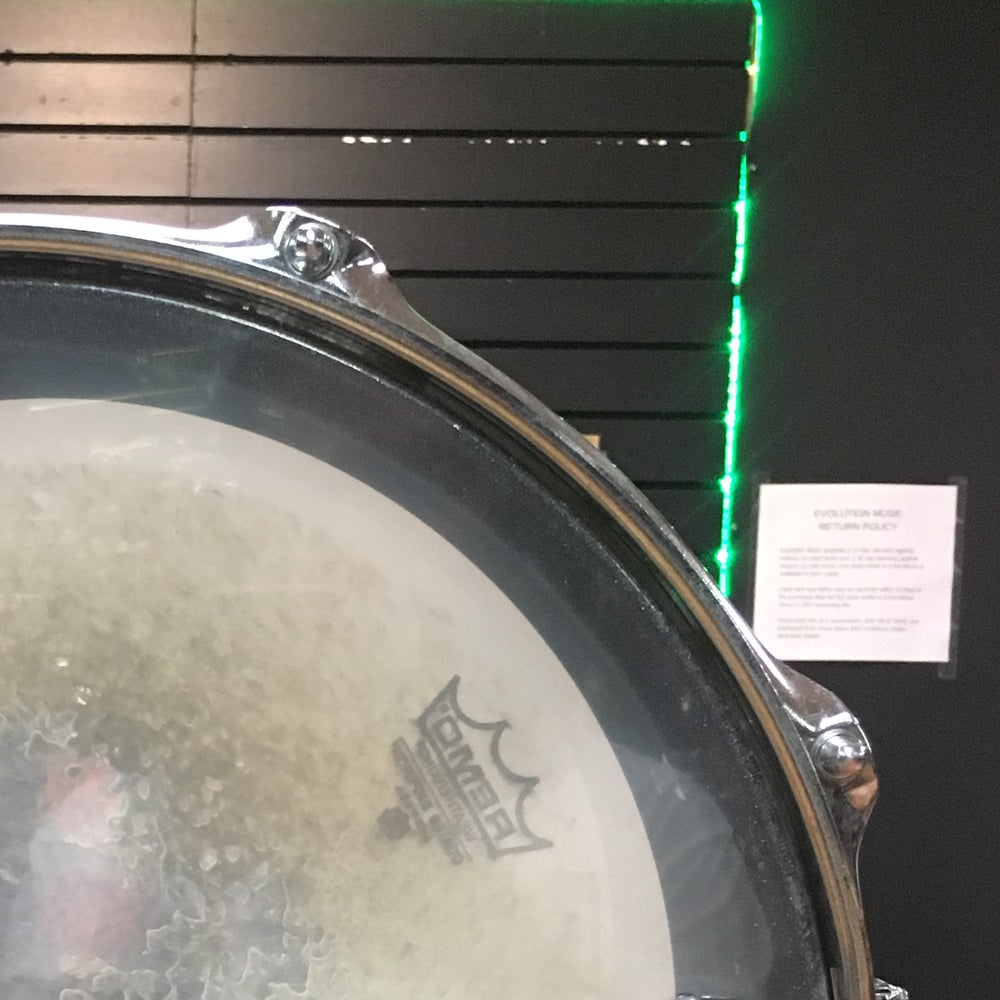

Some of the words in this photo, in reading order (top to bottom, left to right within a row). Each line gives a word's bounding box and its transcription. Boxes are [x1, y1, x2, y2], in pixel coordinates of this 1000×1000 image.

[813, 509, 871, 519] EVOLUTION
[873, 509, 903, 519] MUSIC
[818, 522, 860, 532] RETURN
[862, 522, 898, 532] POLICY
